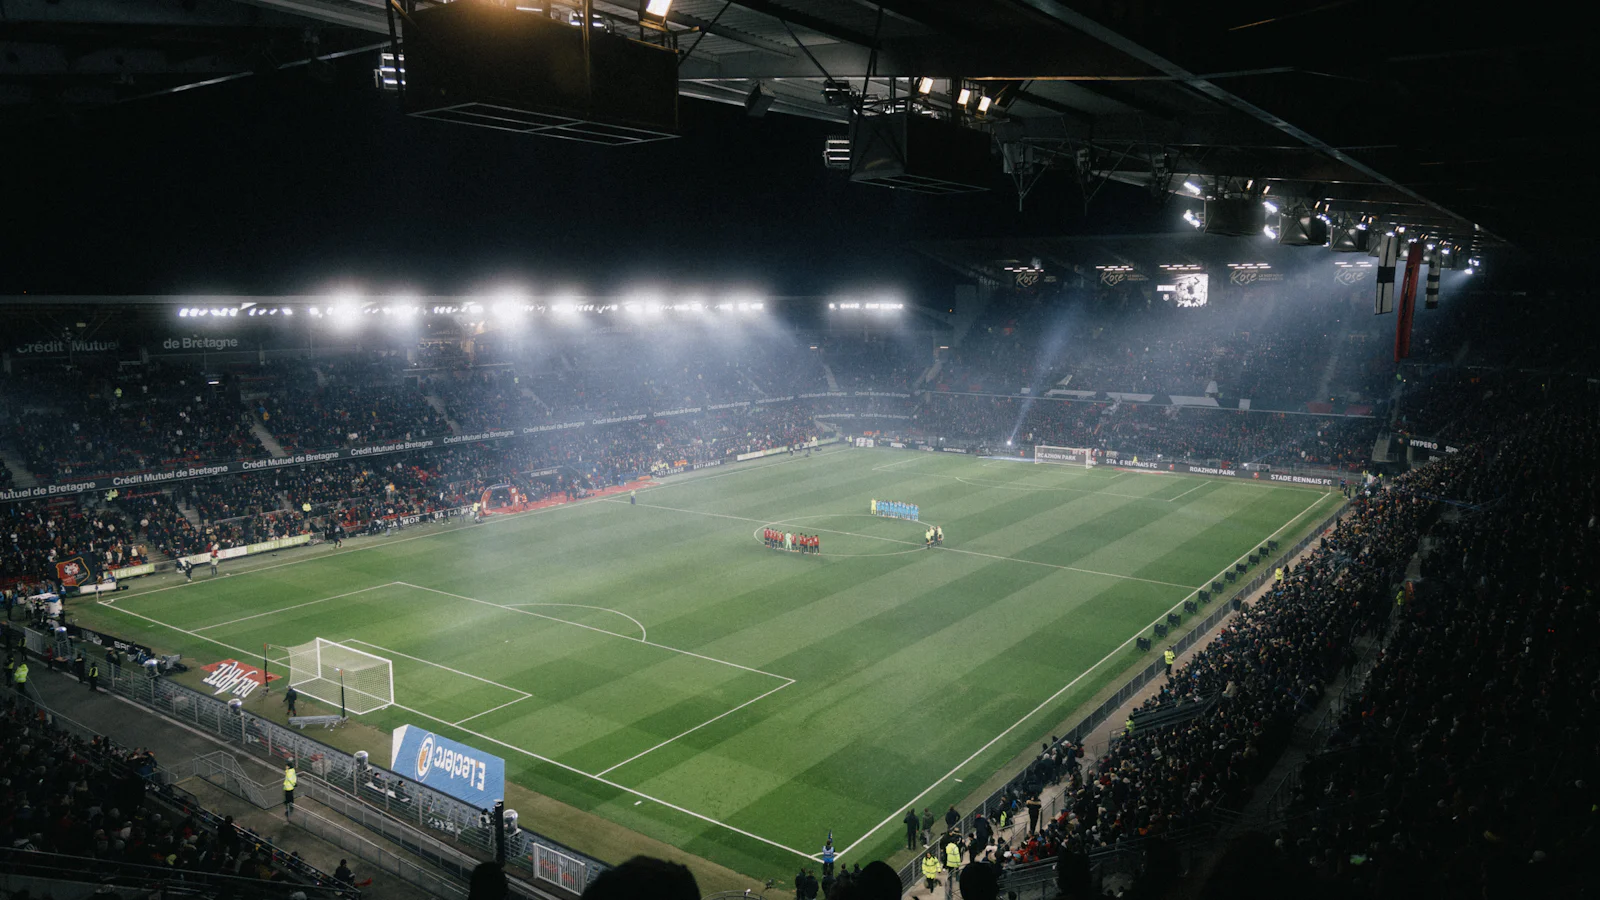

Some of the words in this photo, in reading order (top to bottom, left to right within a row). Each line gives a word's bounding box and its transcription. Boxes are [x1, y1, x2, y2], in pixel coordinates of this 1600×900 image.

[163, 338, 180, 349] de
[182, 337, 238, 350] Bretagne
[523, 425, 539, 433] Crédit
[540, 423, 556, 431] Mutuel
[443, 436, 461, 444] Crédit
[490, 430, 514, 438] Bretagne
[351, 446, 372, 456] Crédit
[373, 443, 395, 453] Mutuel
[396, 442, 404, 450] de
[405, 440, 433, 449] Bretagne
[242, 459, 267, 469] Crédit
[268, 456, 294, 466] Mutuel
[295, 455, 305, 463] de
[305, 452, 339, 461] Bretagne
[1106, 458, 1123, 466] STAE
[113, 474, 142, 485] Crédit
[144, 471, 174, 482] Mutuel
[176, 468, 188, 478] de
[189, 465, 228, 475] Bretagne
[1189, 466, 1218, 475] ROAZHON
[1271, 474, 1292, 482] STADE
[1292, 476, 1322, 485] RENNAIS
[33, 486, 47, 496] de
[48, 481, 96, 494] Bretagne
[203, 661, 258, 696] ARTE
